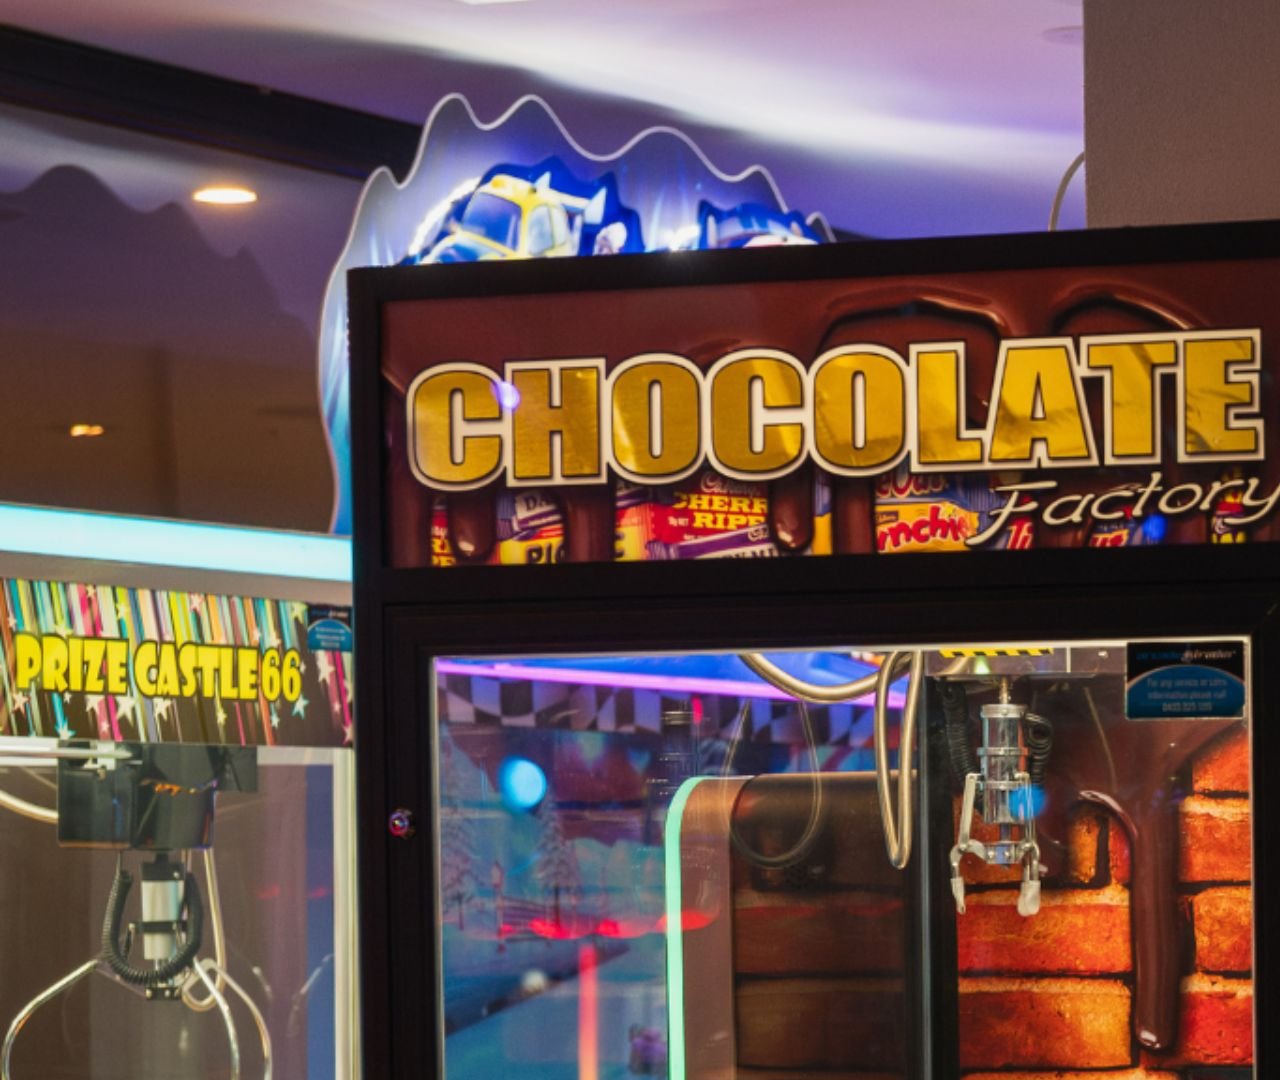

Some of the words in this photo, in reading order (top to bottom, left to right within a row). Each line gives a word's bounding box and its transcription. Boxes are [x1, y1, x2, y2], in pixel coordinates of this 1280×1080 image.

[407, 327, 1266, 492] CHOCOLATE
[15, 633, 129, 694] PRIZE
[134, 641, 260, 701] CASTLE
[262, 648, 302, 702] 66
